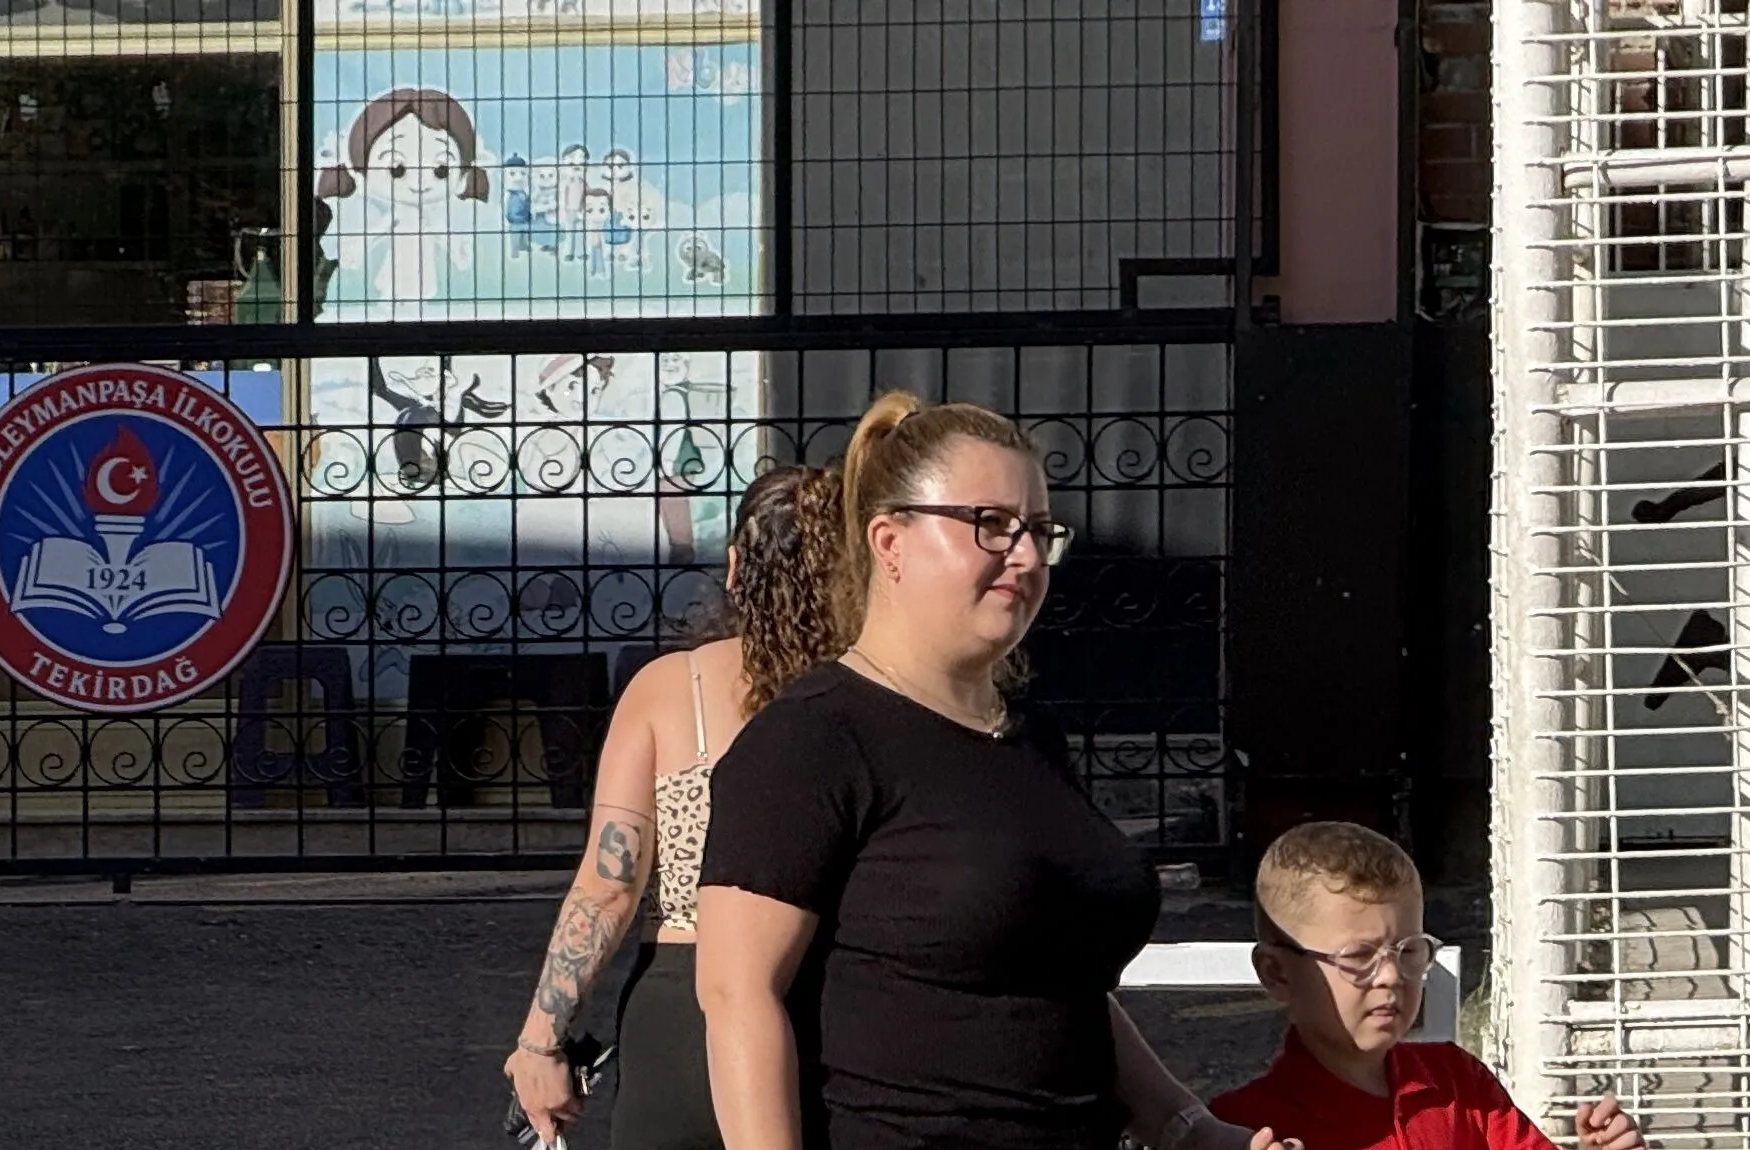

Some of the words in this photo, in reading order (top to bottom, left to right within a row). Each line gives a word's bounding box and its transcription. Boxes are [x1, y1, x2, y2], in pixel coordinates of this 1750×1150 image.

[173, 387, 272, 508] İLKOKULU
[85, 568, 147, 591] 1924
[29, 652, 198, 699] TEKİRDAĞ
